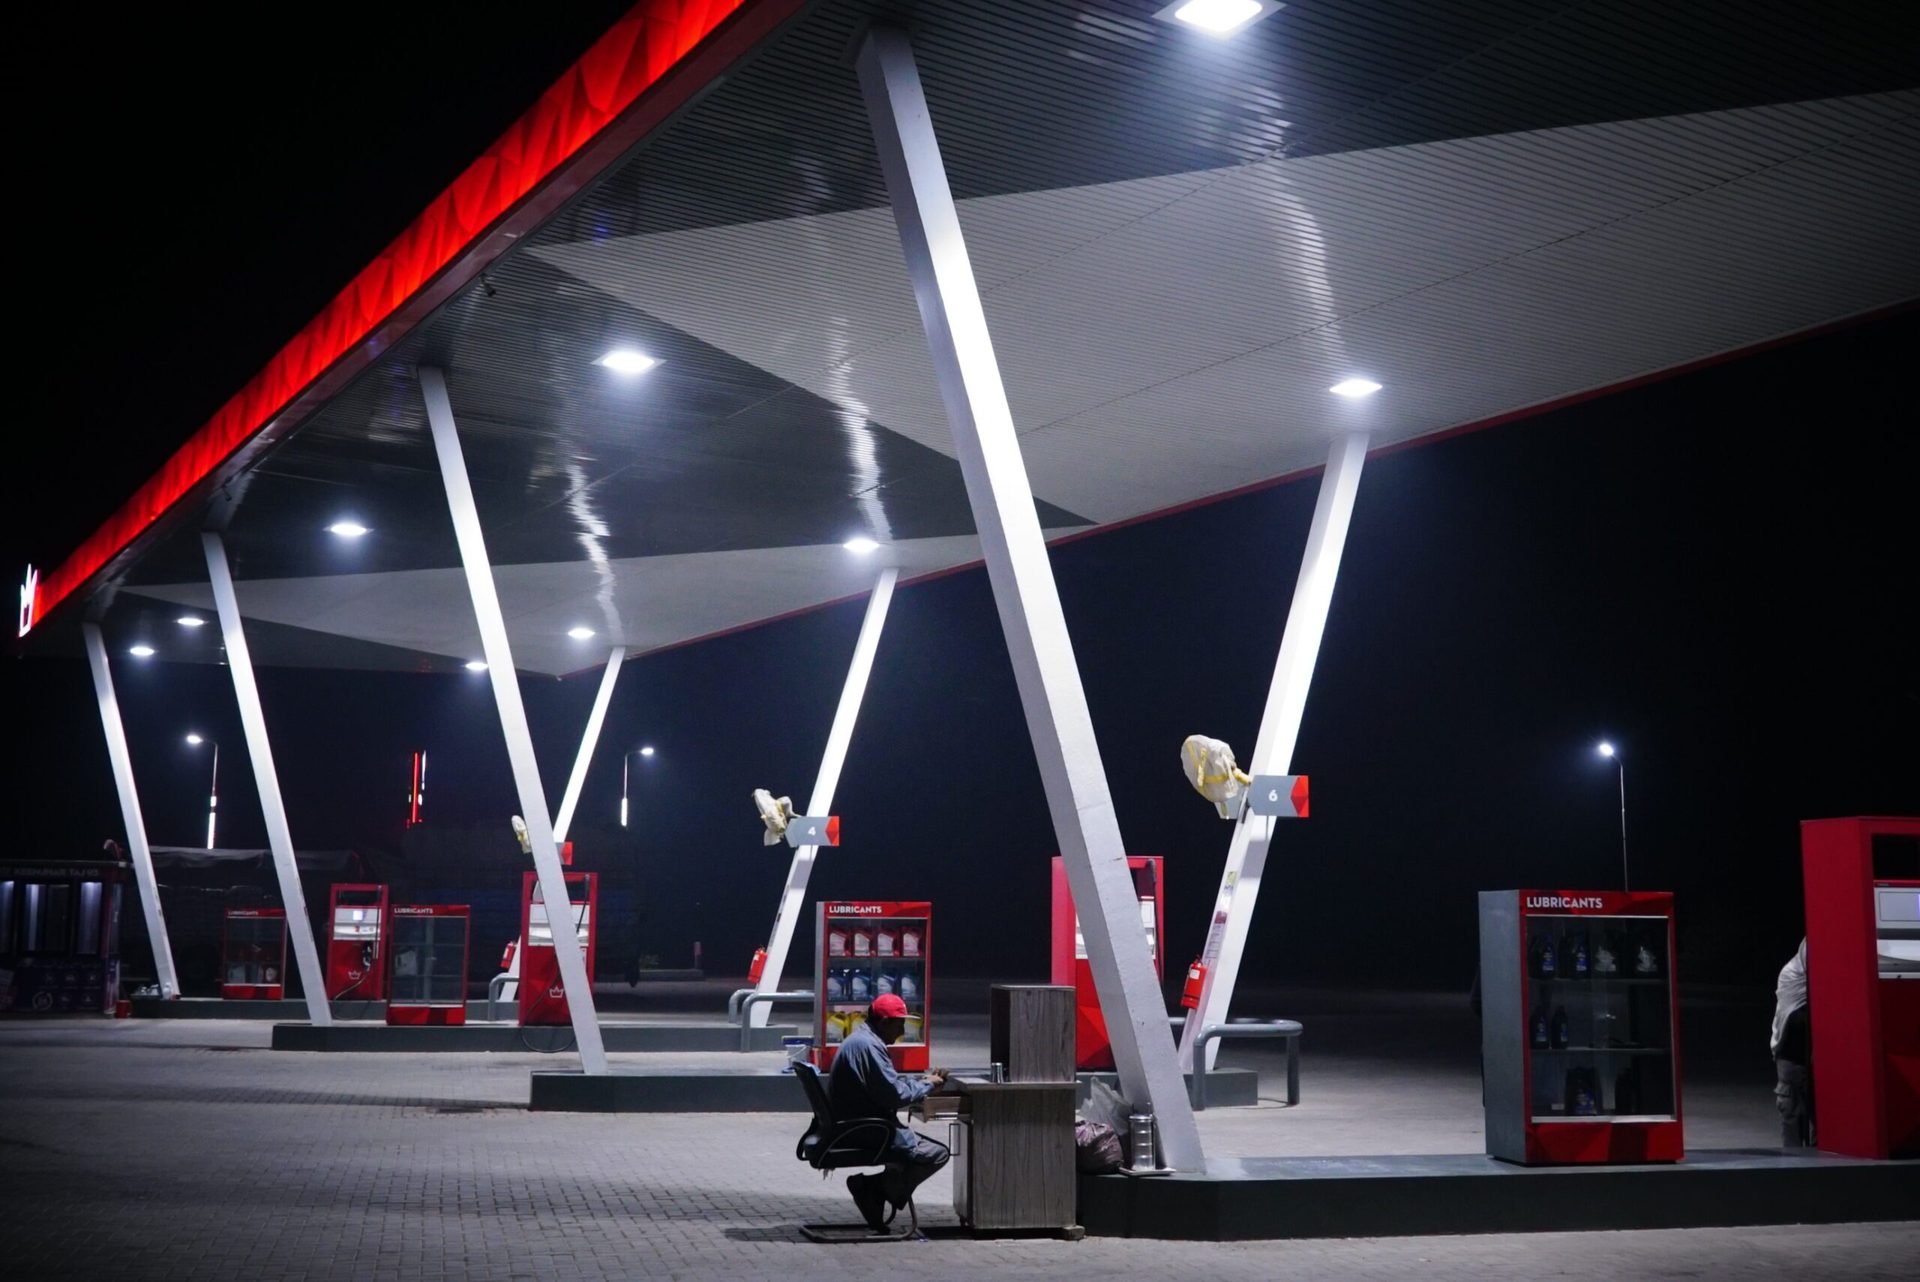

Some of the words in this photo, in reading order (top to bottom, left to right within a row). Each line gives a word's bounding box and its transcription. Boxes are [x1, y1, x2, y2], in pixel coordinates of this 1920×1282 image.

[1268, 789, 1278, 802] 6
[808, 826, 816, 836] 4
[1526, 896, 1603, 909] LUBRICANTS
[829, 905, 882, 914] LUBRICANTS
